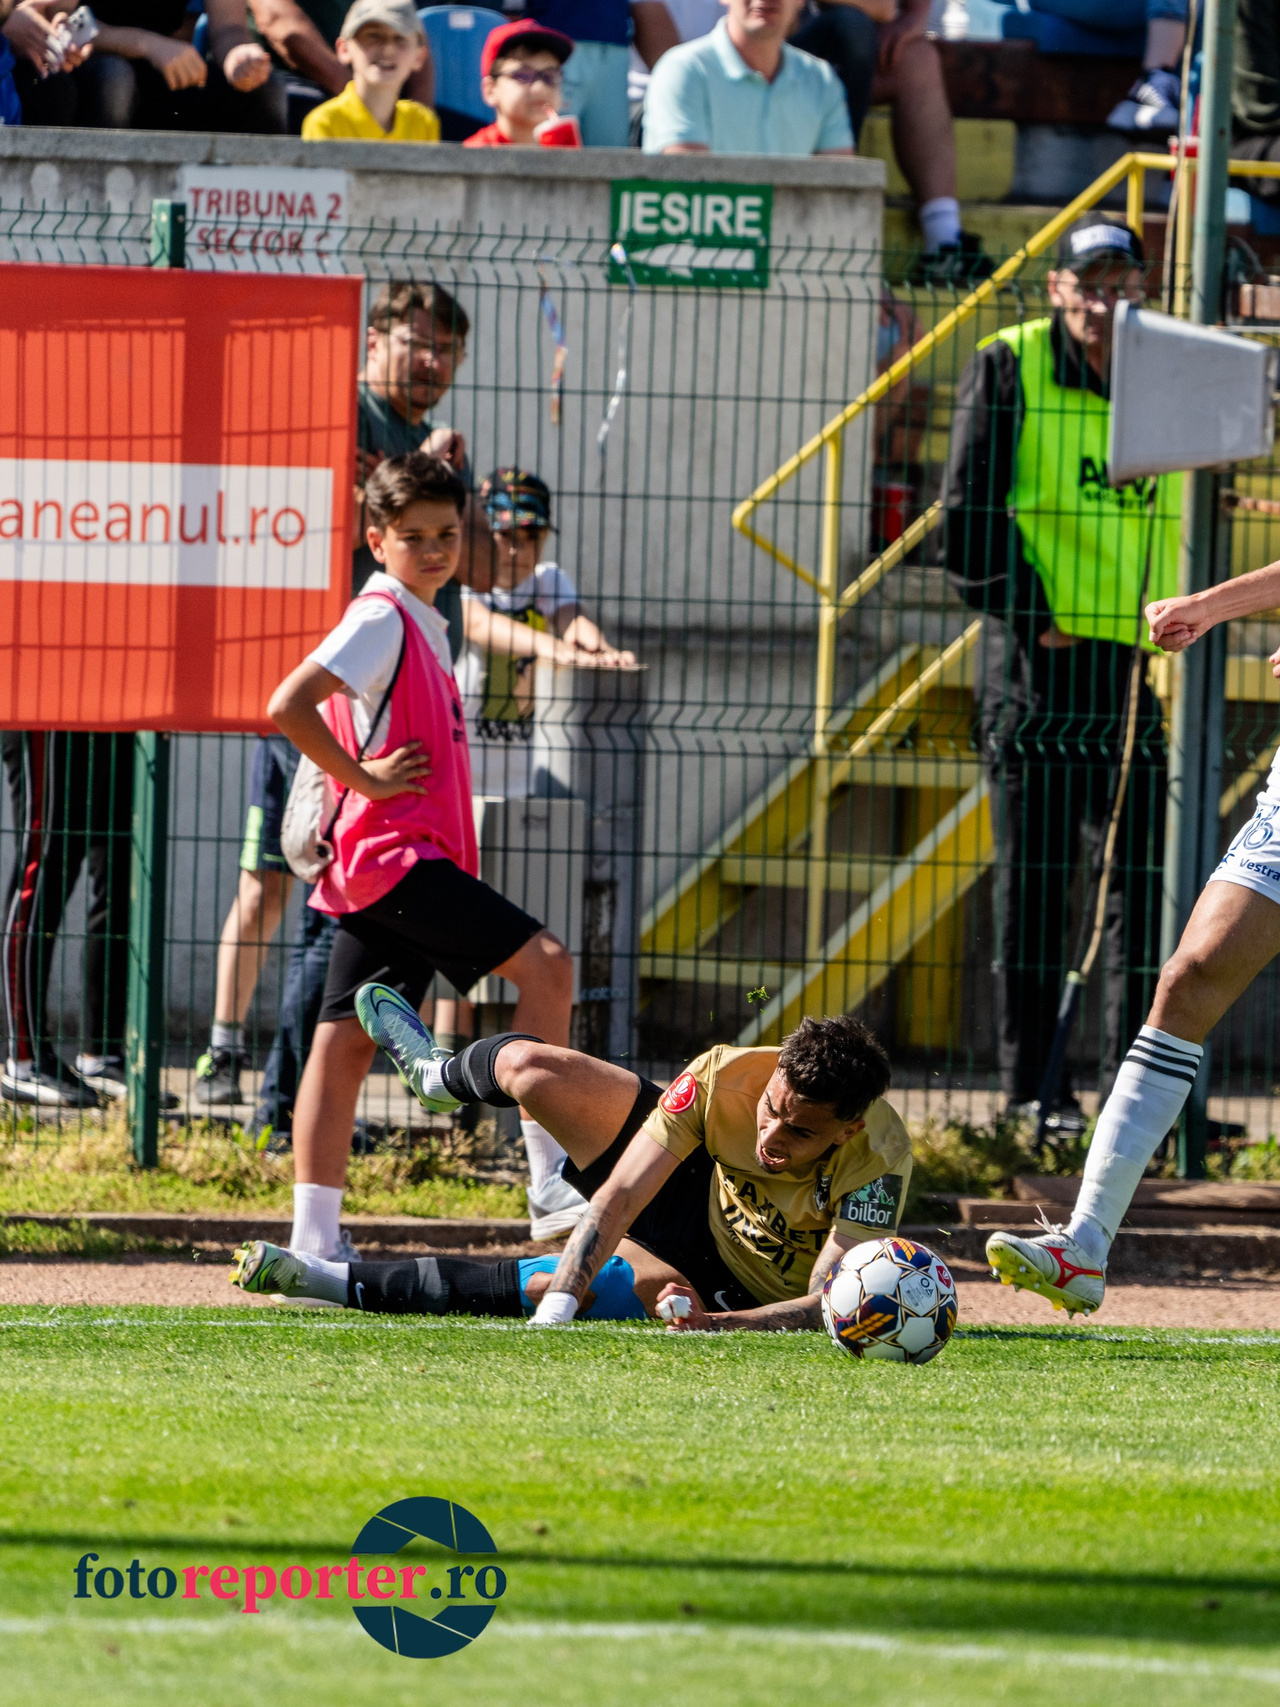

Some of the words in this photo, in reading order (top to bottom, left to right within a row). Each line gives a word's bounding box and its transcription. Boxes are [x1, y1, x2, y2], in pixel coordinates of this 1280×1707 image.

[189, 187, 317, 218] TRIBUNA
[327, 192, 342, 220] 2
[619, 191, 763, 237] IESIRE
[196, 226, 304, 257] SECTOR
[315, 231, 331, 259] C
[0, 490, 307, 548] aneanul.ro
[847, 1201, 893, 1225] bilbor
